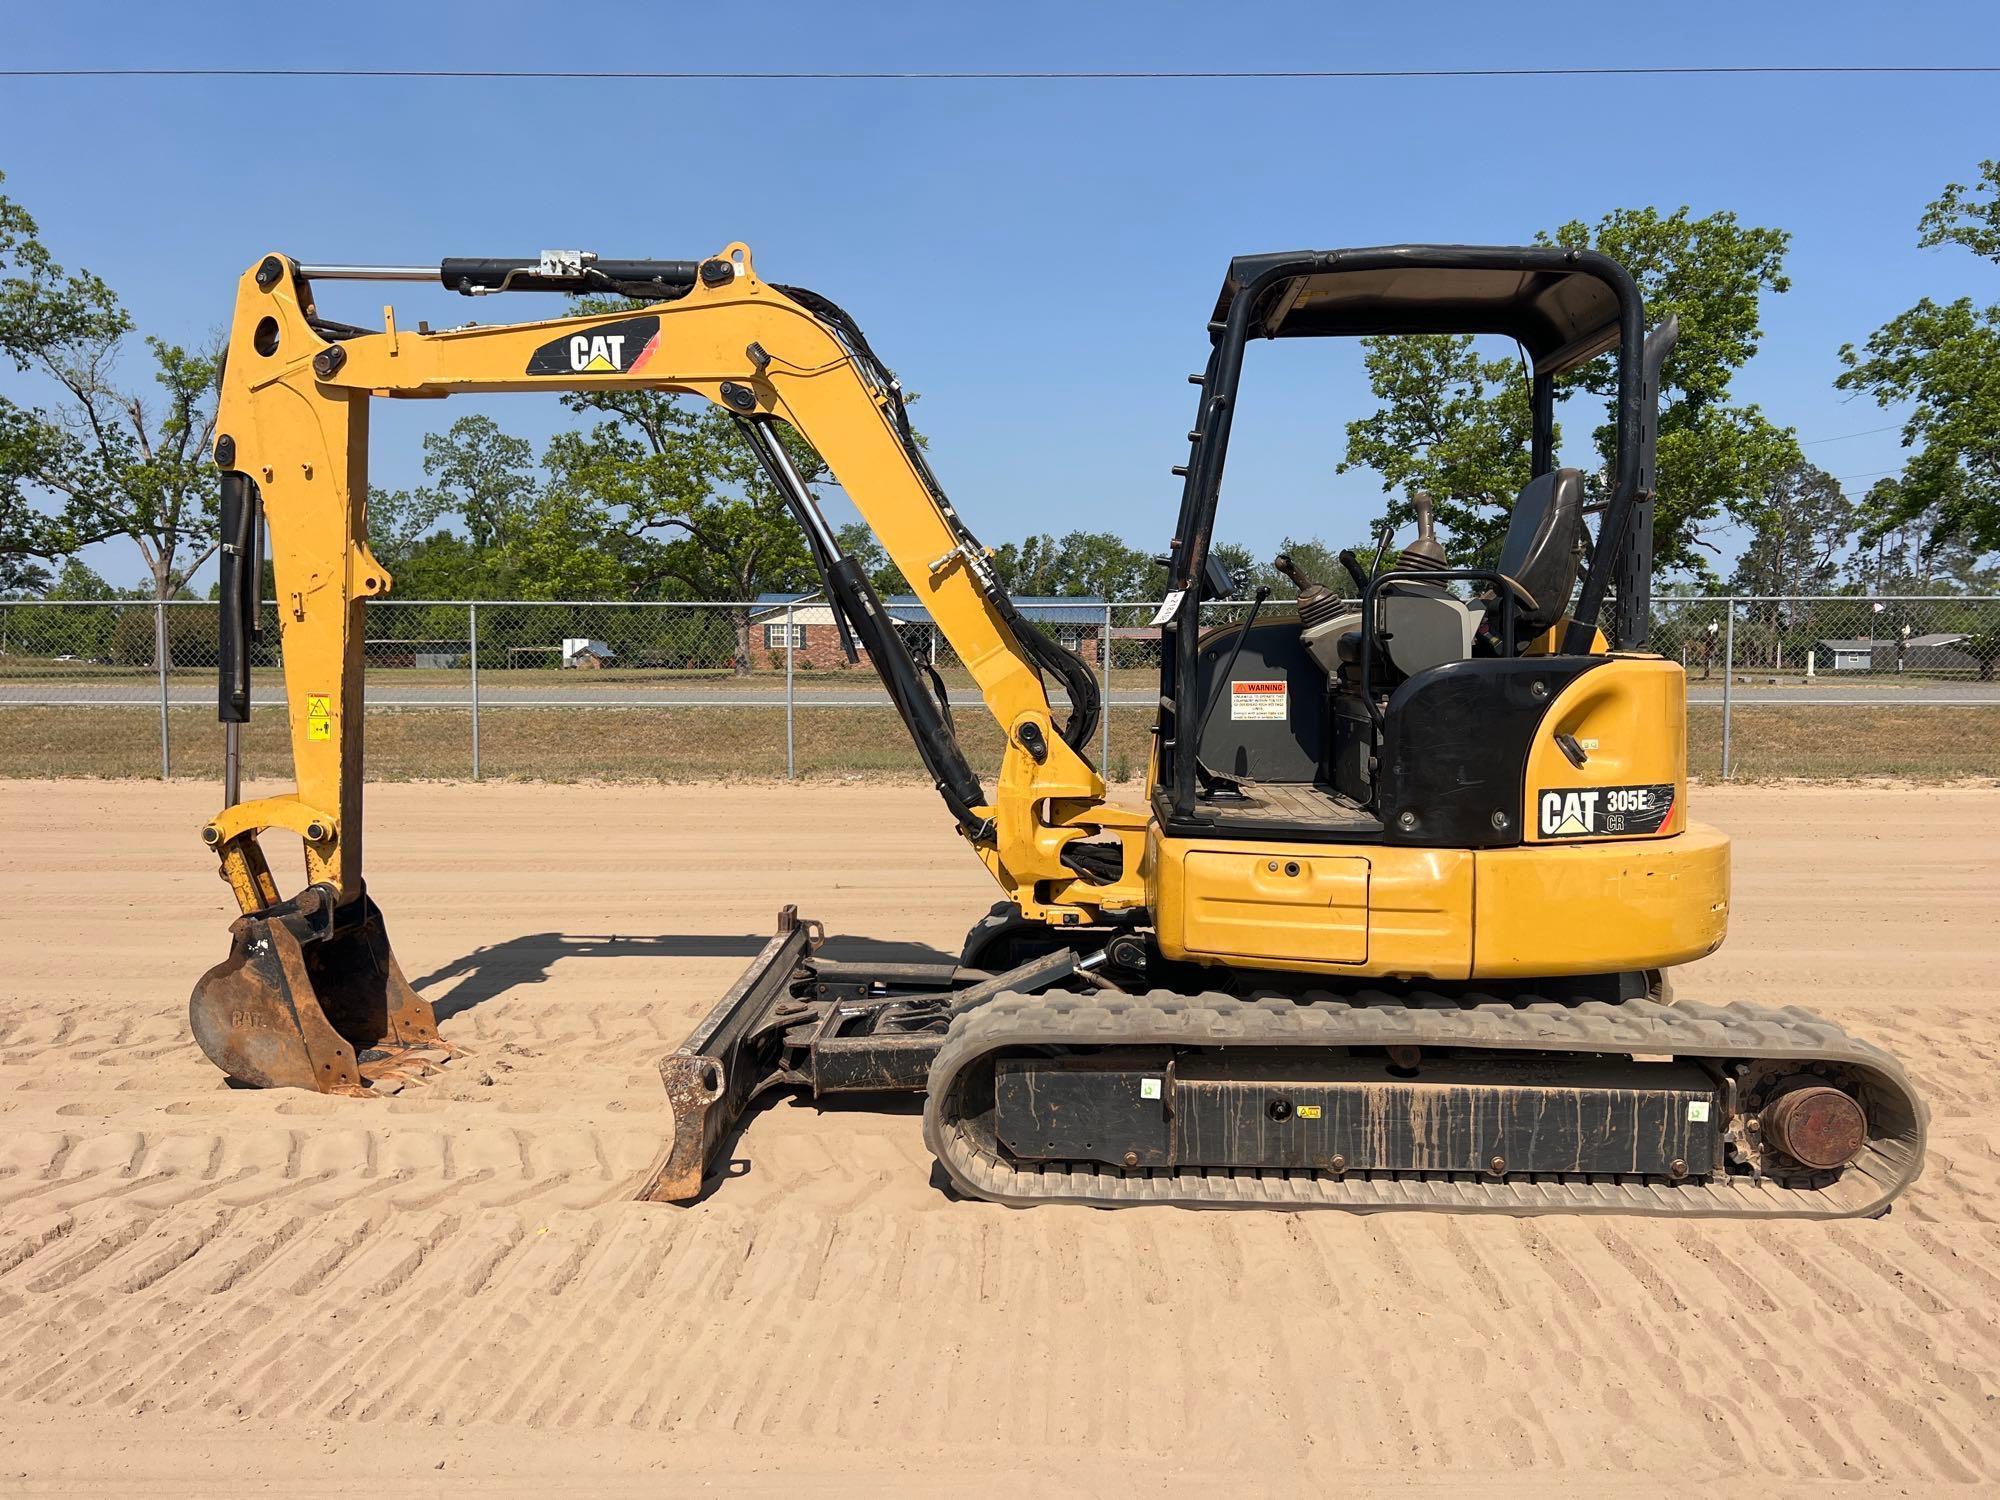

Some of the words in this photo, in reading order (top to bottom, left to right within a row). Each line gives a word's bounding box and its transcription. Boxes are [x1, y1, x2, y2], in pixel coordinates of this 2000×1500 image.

[570, 335, 625, 371] CAT
[1542, 792, 1599, 835] CAT
[1607, 789, 1656, 812] 305E2
[1606, 815, 1624, 831] CR
